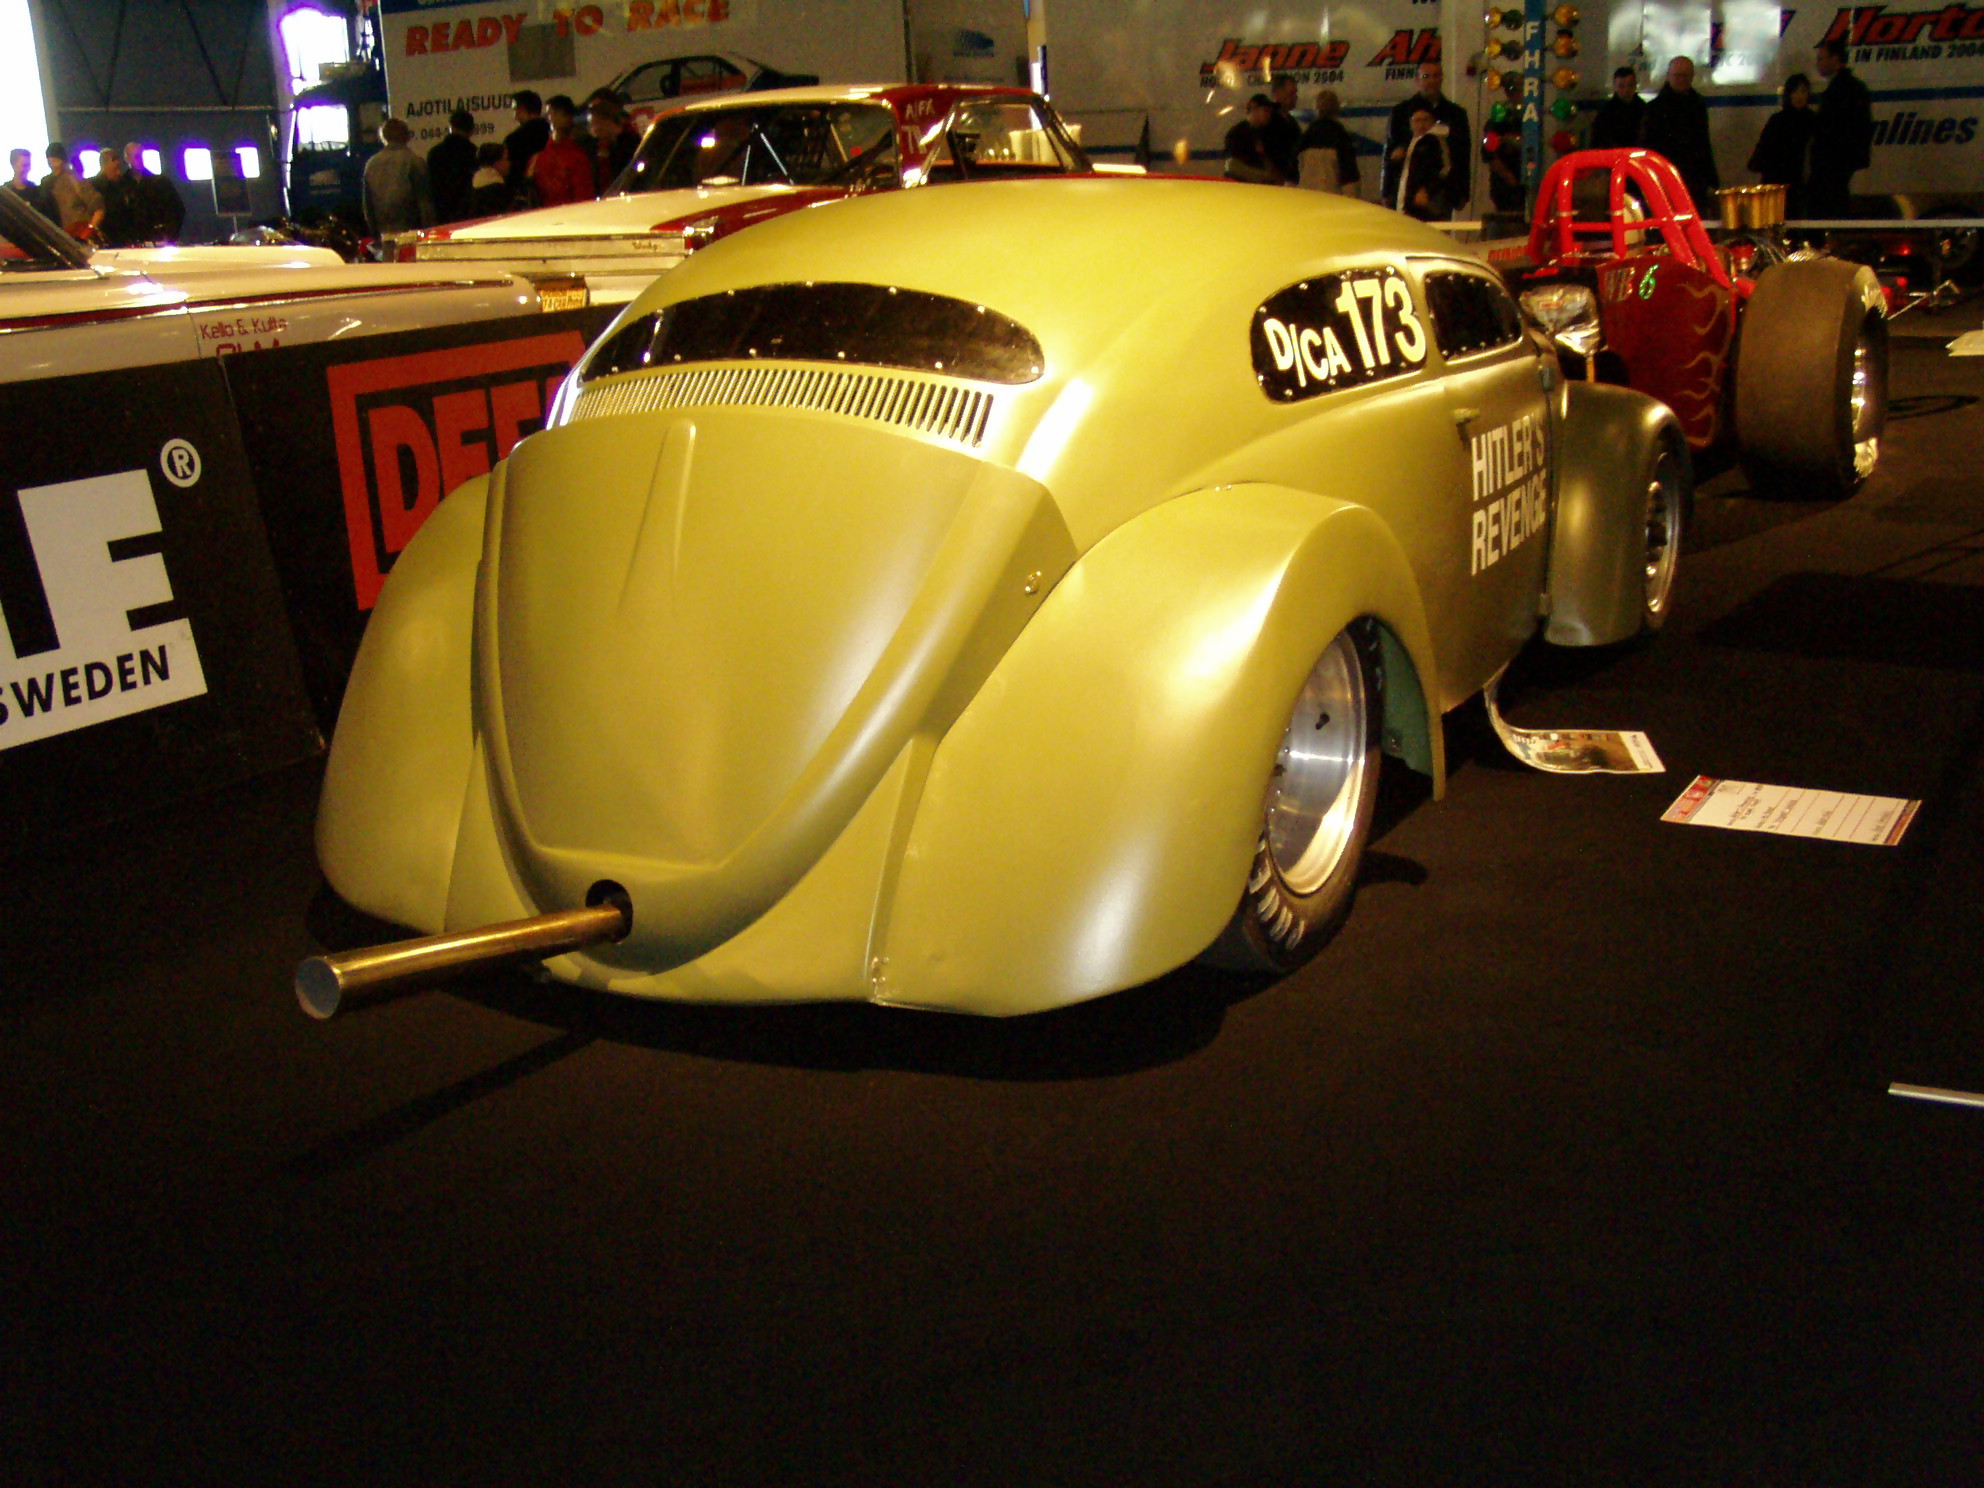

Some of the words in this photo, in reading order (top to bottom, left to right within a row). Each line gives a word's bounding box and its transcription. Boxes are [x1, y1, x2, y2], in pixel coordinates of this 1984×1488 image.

[406, 13, 527, 57] READY
[552, 5, 605, 38] TO
[627, 0, 731, 34] RACE
[1199, 38, 1351, 75] Janne
[1875, 45, 1942, 62] FINLAND
[1522, 21, 1541, 123] FHRA
[1639, 264, 1659, 300] 6
[1263, 317, 1352, 388] D/CA
[1335, 276, 1427, 369] 173
[1471, 412, 1545, 502] HITLER'S
[1470, 467, 1547, 577] REVENGE
